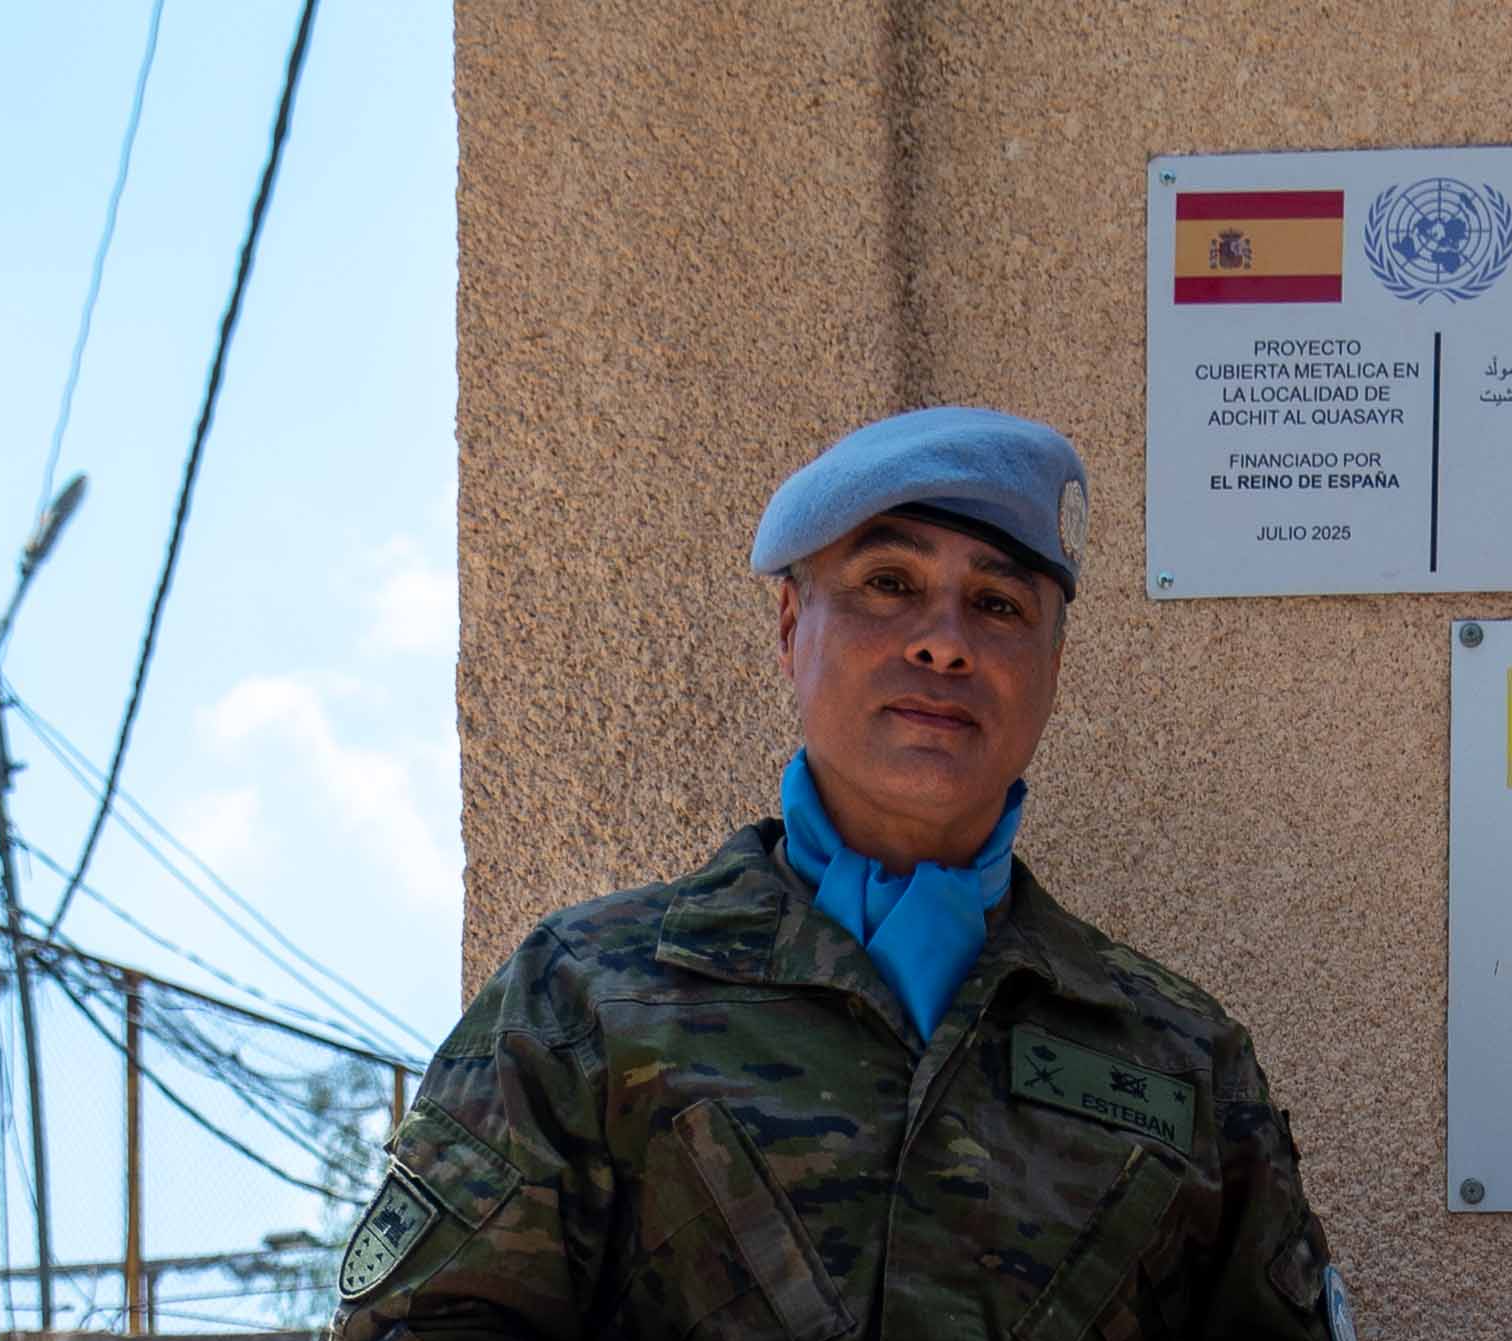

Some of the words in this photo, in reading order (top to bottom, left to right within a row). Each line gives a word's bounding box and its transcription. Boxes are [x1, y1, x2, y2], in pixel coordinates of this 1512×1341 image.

[1254, 340, 1361, 356] PROYECTO
[1195, 363, 1290, 380] CUBIERTA
[1295, 363, 1389, 379] METALICA
[1393, 362, 1419, 378] EN
[1223, 387, 1246, 403] LA
[1251, 386, 1359, 402] LOCALIDAD
[1365, 385, 1390, 401] DE
[1208, 409, 1280, 425] ADCHIT
[1283, 410, 1306, 424] AL
[1311, 408, 1403, 424] QUASAYR
[1230, 453, 1338, 468] FINANCIADO
[1343, 453, 1381, 467] POR
[1211, 475, 1232, 490] EL
[1238, 475, 1293, 489] REINO
[1298, 474, 1322, 489] DE
[1328, 471, 1399, 488] ESPAÑA
[1257, 526, 1307, 541] JULIO
[1312, 526, 1351, 540] 2025
[1082, 1093, 1175, 1141] ESTEBAN
